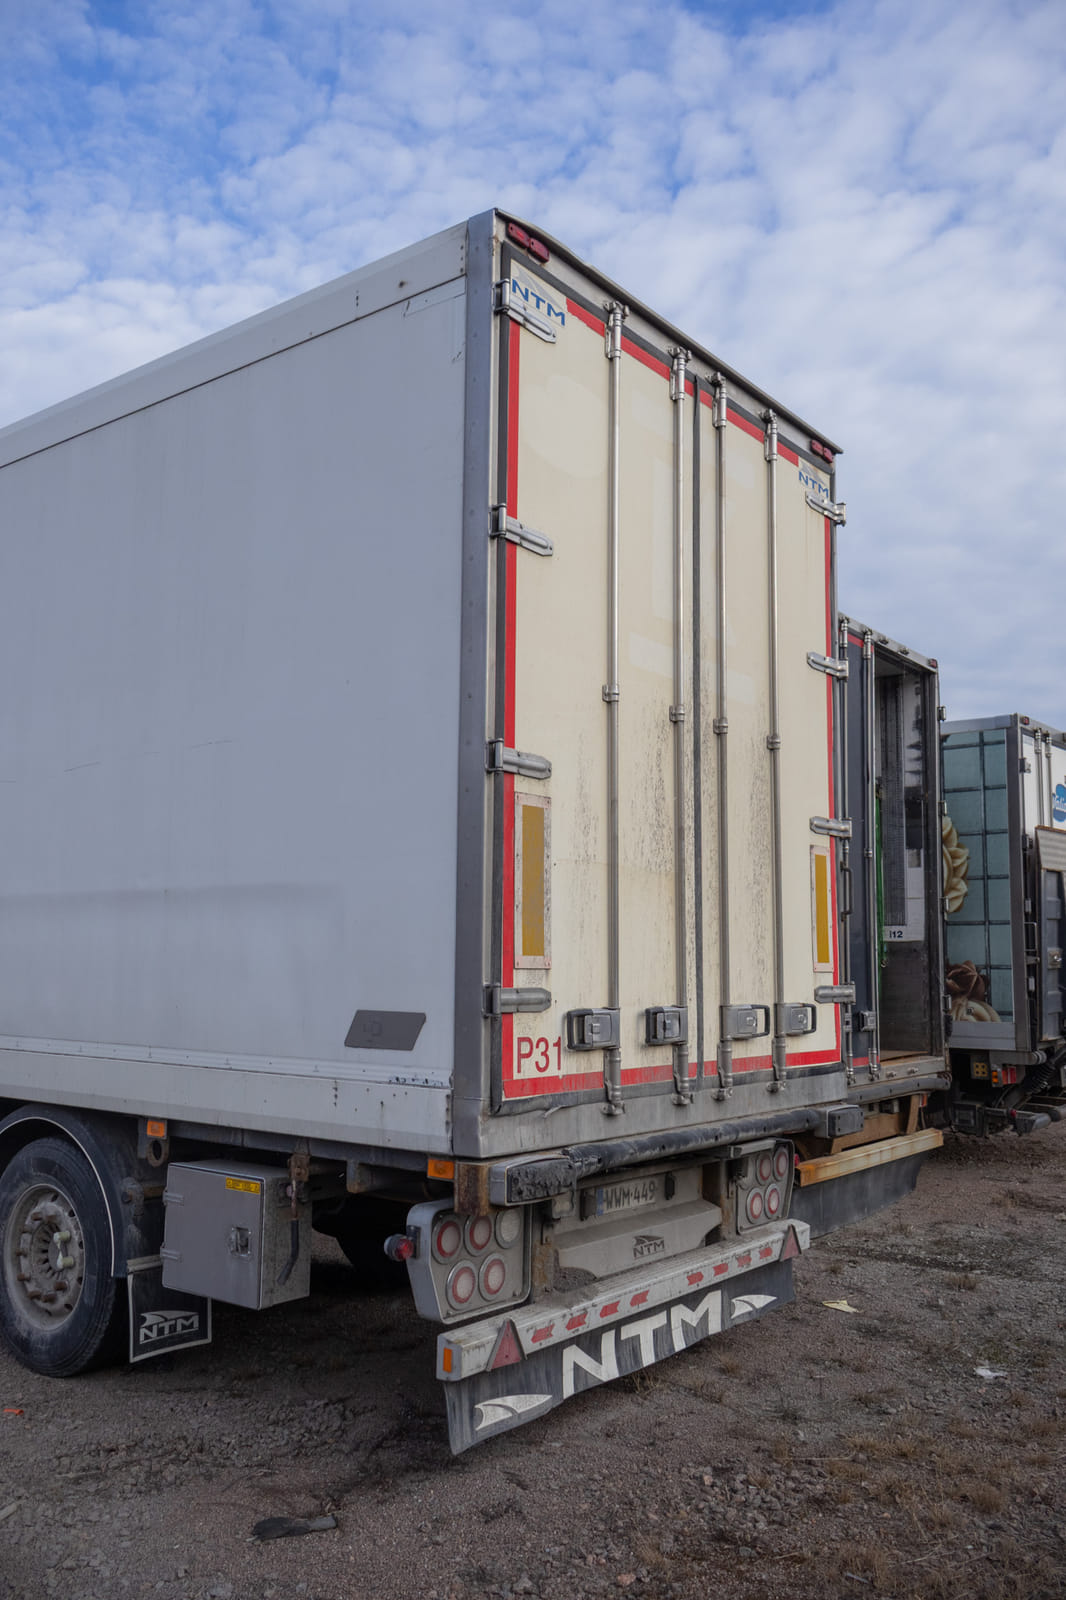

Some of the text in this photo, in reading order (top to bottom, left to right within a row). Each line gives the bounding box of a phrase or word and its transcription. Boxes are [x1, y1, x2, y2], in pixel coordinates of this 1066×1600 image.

[512, 279, 565, 326] NTM
[799, 471, 828, 498] NTM
[517, 1036, 561, 1073] P31
[633, 1240, 664, 1258] NTM
[140, 1315, 199, 1344] NTM
[563, 1289, 722, 1400] NTM
